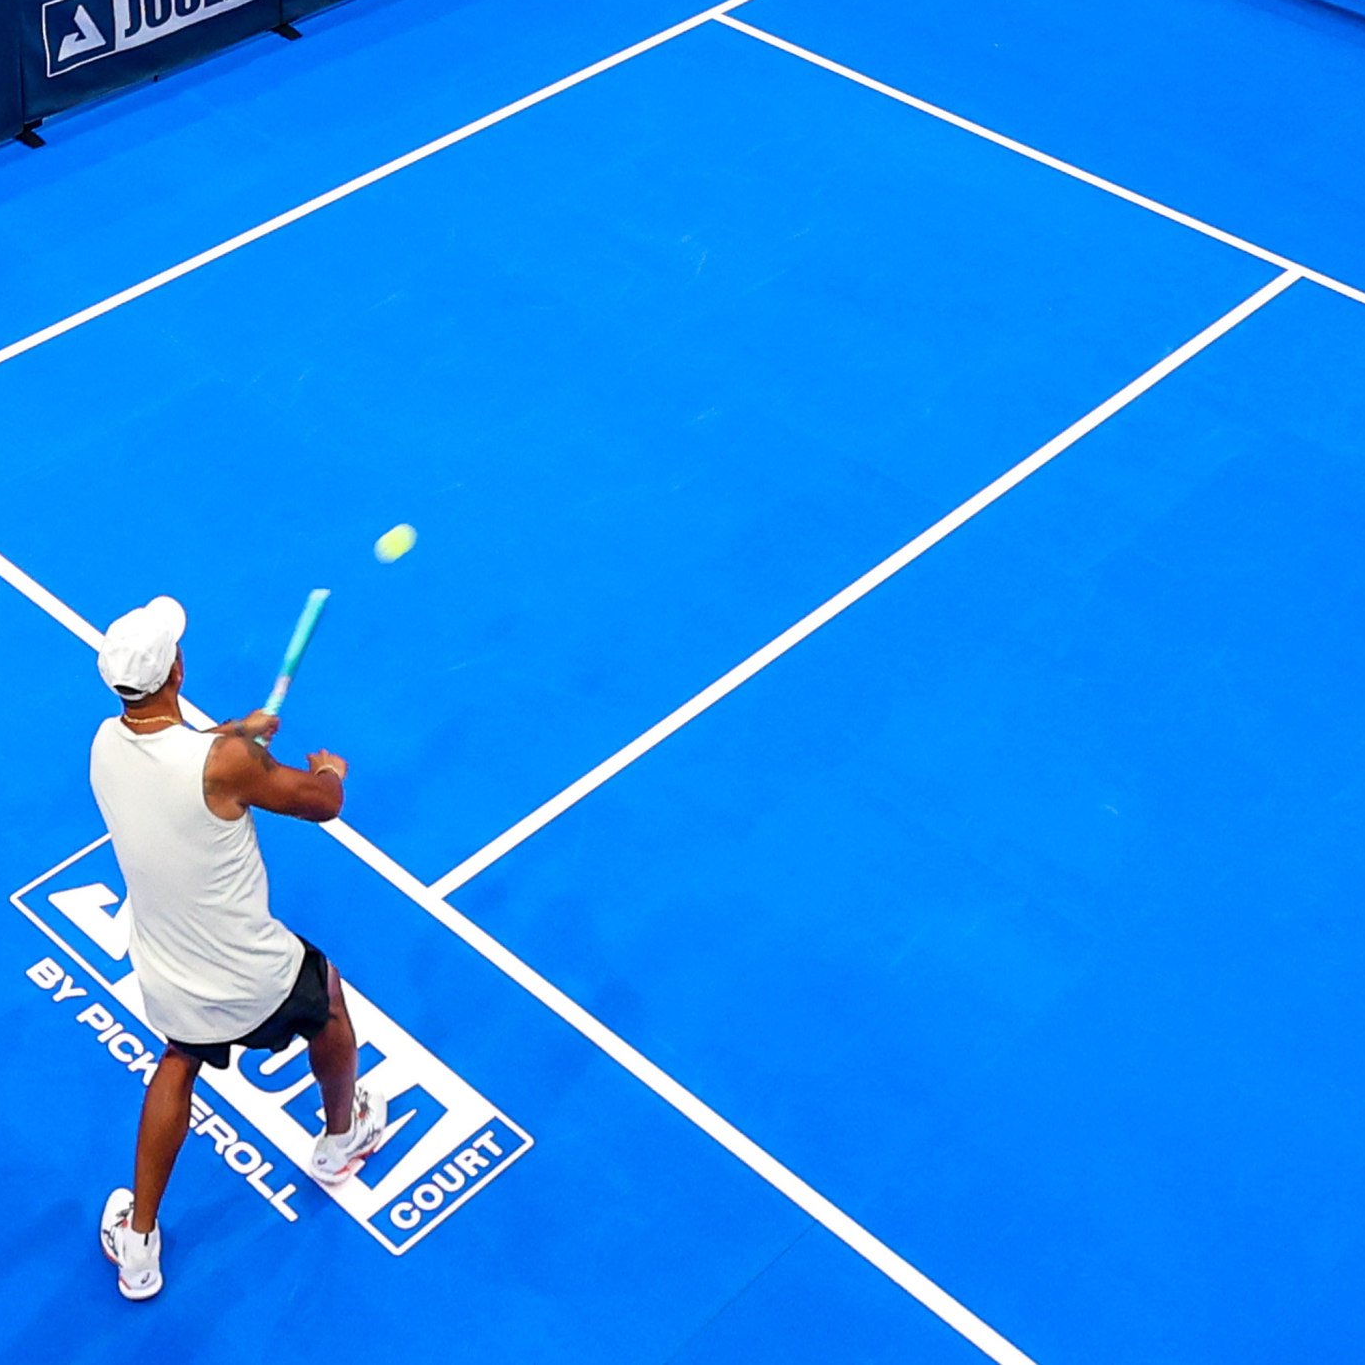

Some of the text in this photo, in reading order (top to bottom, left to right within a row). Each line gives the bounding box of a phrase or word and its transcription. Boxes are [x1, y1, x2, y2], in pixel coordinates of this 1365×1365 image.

[25, 957, 300, 1223] BY PICKEROLL
[389, 1129, 505, 1232] COURT
